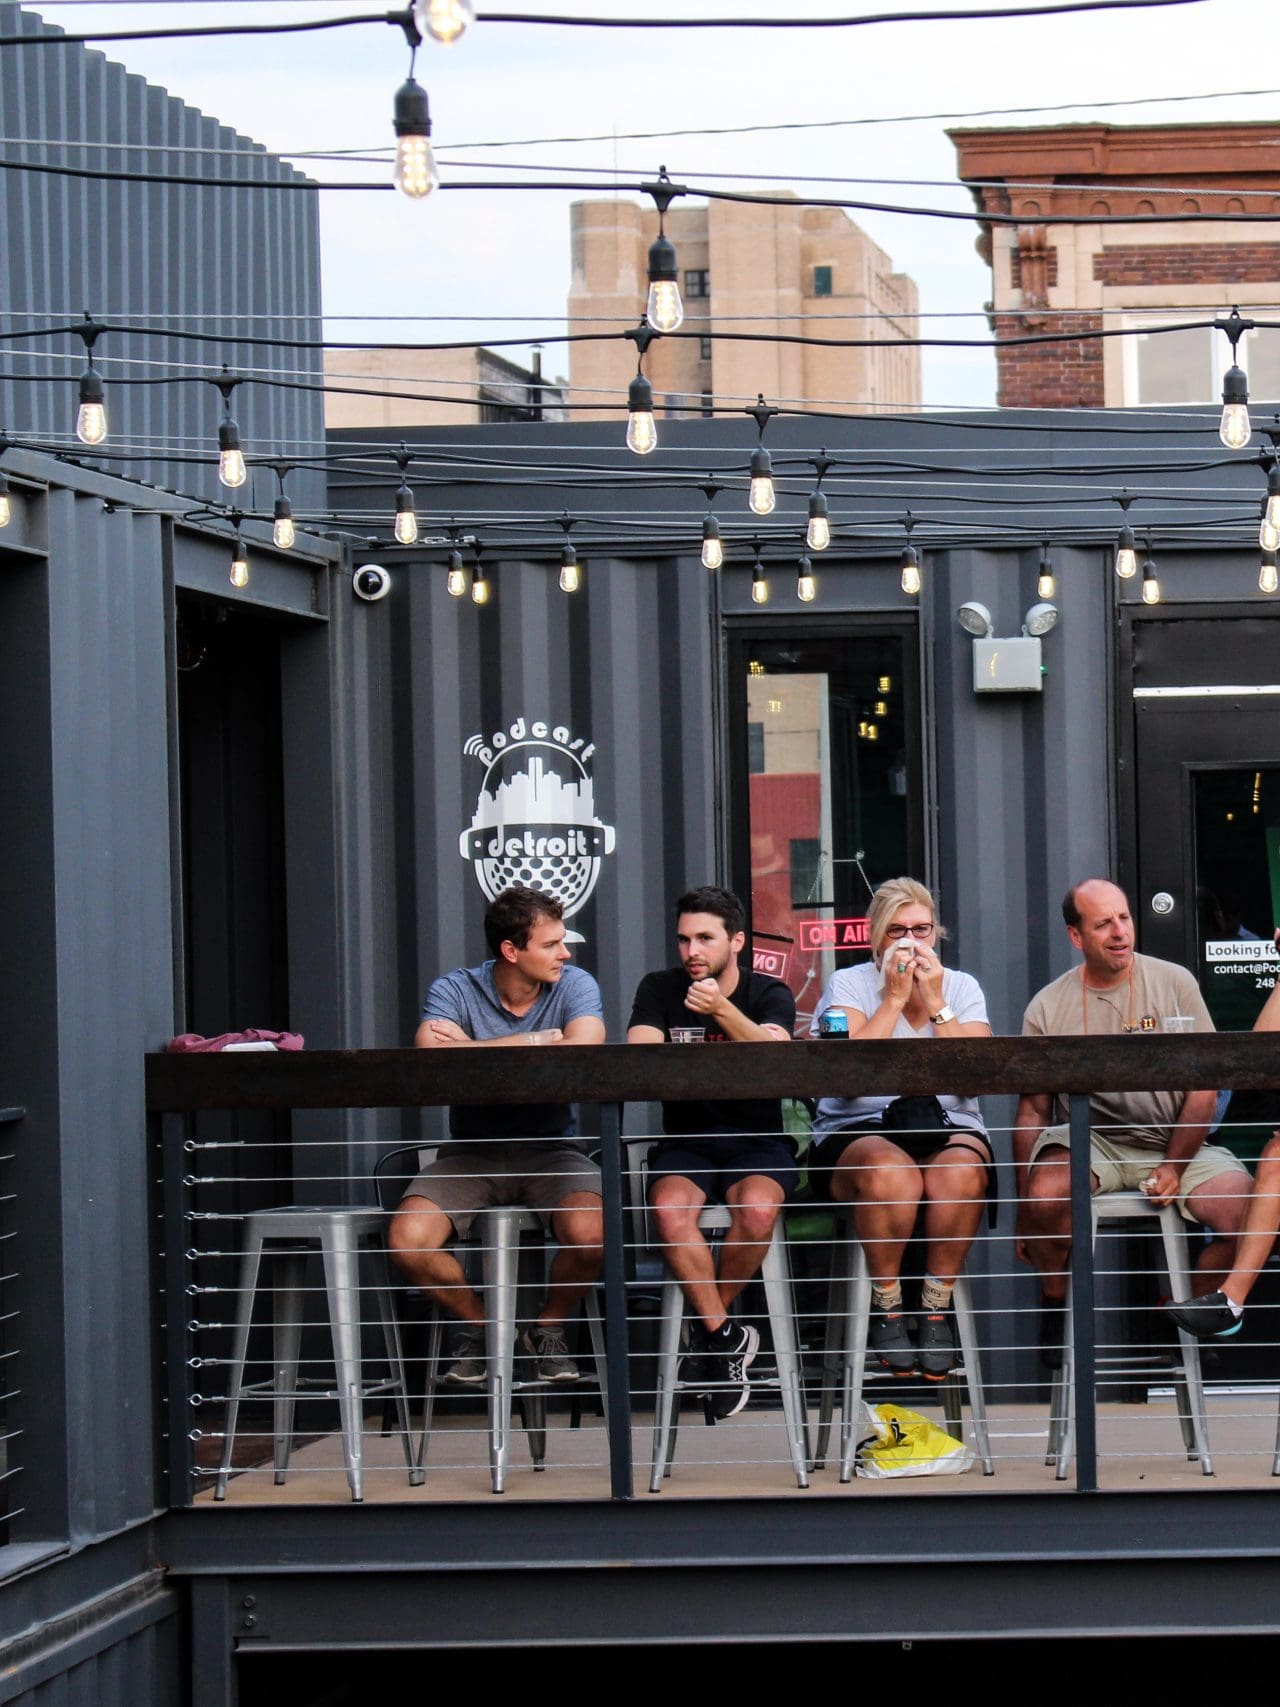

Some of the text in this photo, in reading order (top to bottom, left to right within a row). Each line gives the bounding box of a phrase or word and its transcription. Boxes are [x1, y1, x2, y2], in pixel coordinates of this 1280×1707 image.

[487, 824, 588, 858] detroit
[809, 926, 837, 945] ON
[1208, 944, 1277, 958] Looking fo
[1255, 978, 1275, 989] 248
